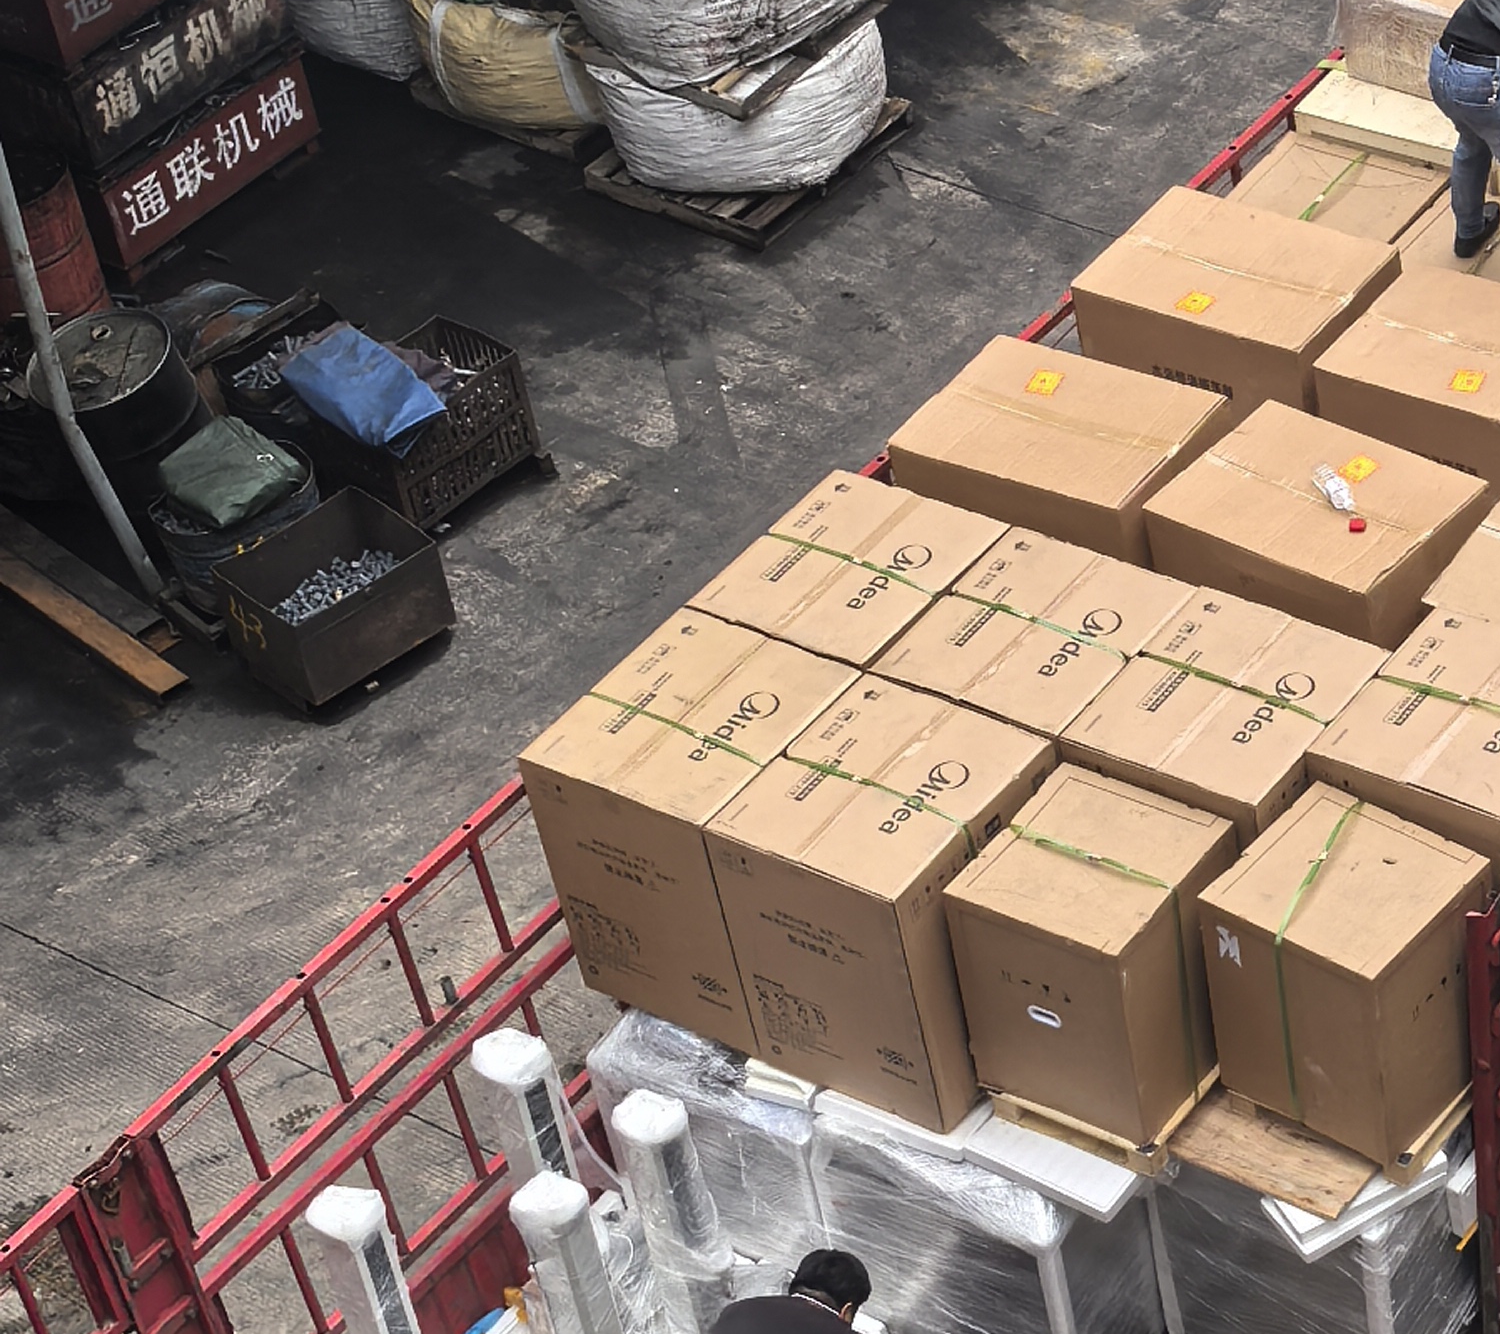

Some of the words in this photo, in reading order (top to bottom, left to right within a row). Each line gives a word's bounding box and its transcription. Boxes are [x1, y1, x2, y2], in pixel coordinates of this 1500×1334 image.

[122, 75, 305, 236] 通联机械
[846, 544, 933, 609] Mdea
[1037, 608, 1122, 677] Mdea
[1232, 672, 1316, 744] Mdea
